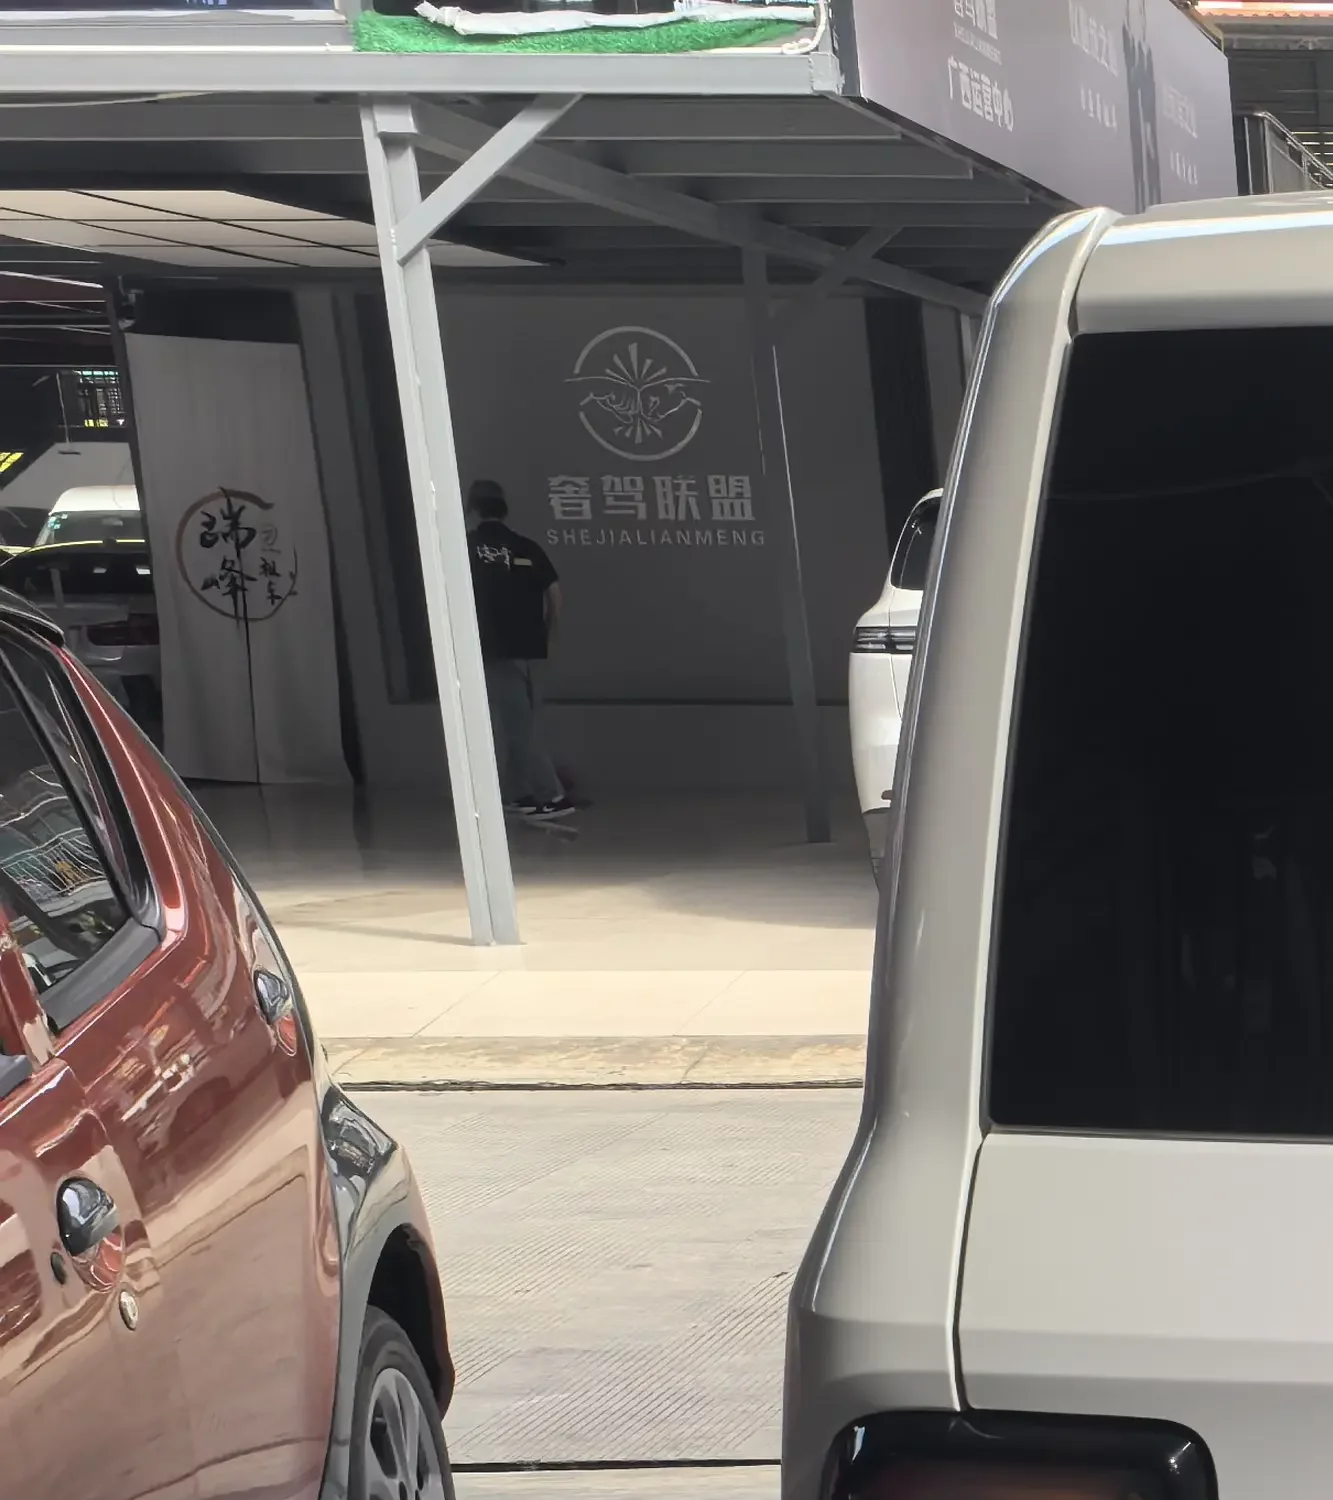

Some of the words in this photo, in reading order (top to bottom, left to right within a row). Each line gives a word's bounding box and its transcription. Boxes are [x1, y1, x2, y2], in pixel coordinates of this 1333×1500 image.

[547, 474, 757, 522] 奢驾联盟
[546, 529, 765, 547] SHEJIALIANMENG
